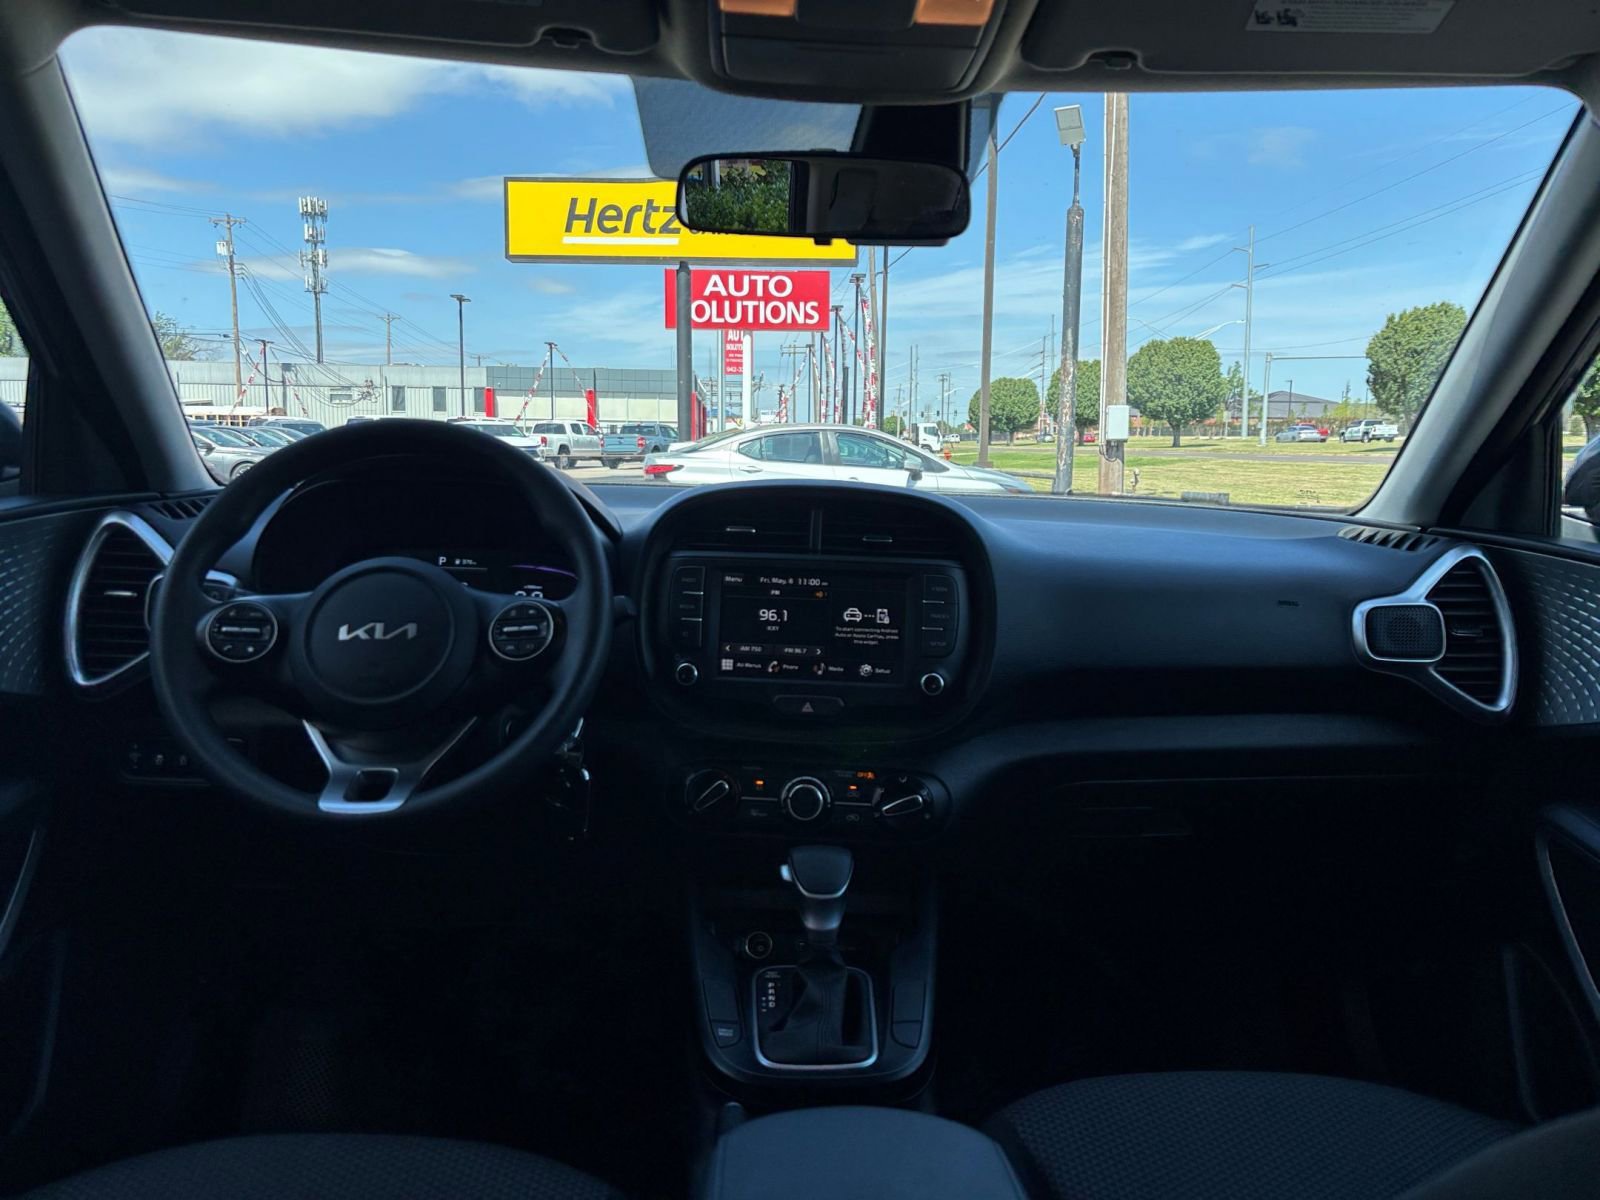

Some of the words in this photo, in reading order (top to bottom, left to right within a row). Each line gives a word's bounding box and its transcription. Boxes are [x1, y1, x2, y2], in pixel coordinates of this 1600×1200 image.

[565, 197, 681, 234] Hertz
[703, 274, 793, 298] AUTO
[691, 300, 819, 324] OLUTIONS
[438, 556, 447, 566] P
[797, 578, 821, 586] 11:00
[759, 609, 788, 623] 96.1
